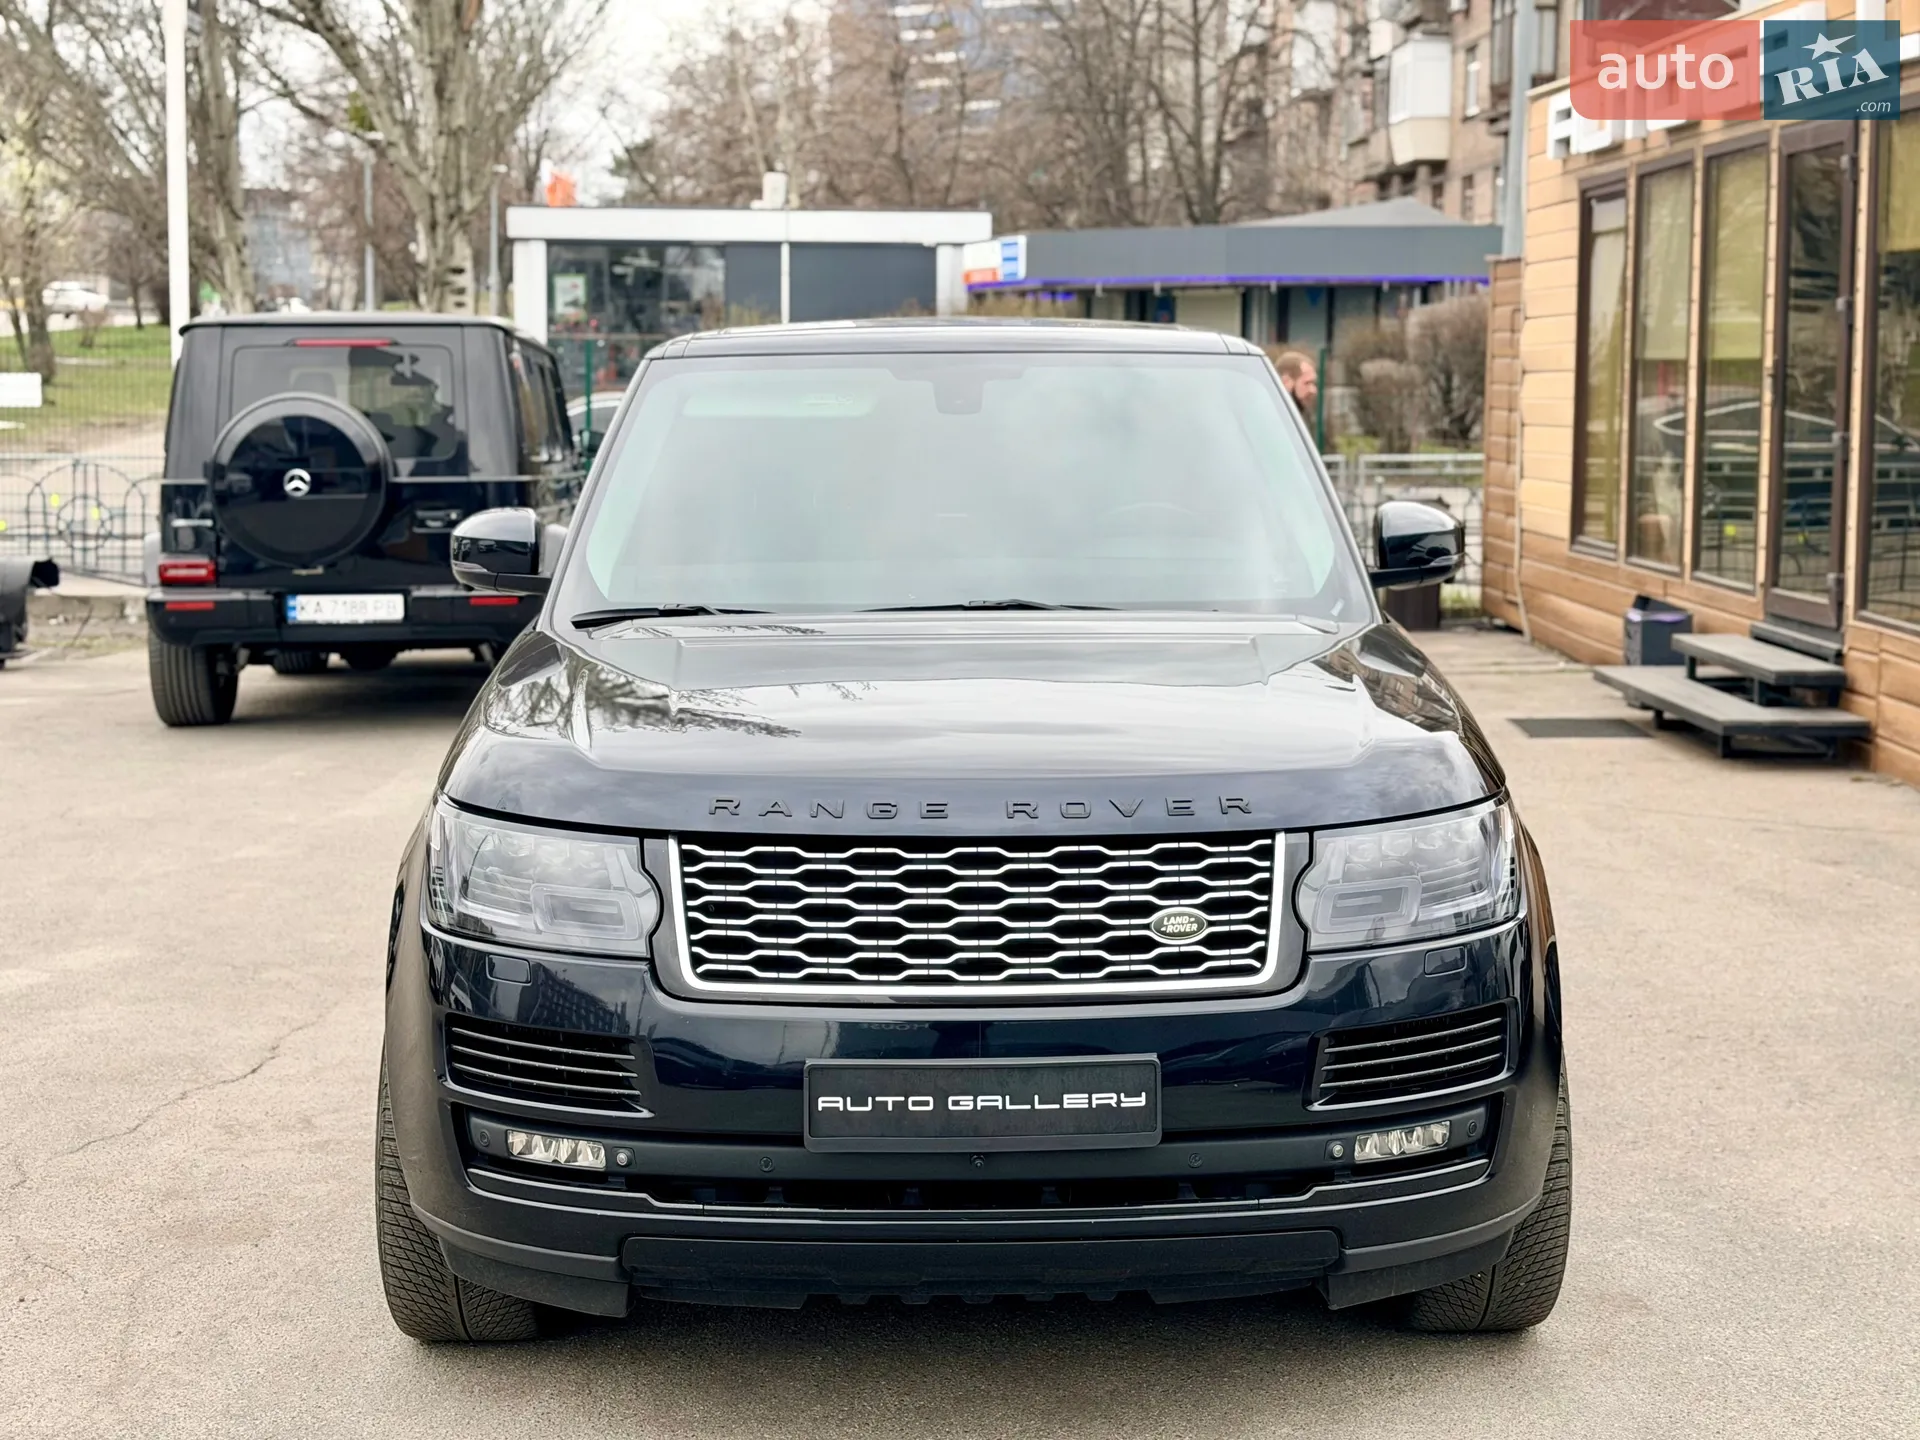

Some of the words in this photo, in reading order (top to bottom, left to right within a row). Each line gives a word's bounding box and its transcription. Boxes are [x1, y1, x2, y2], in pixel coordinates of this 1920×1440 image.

[707, 796, 950, 820] RANGE
[1005, 794, 1254, 819] ROVER
[1166, 923, 1198, 934] ROVER
[817, 1095, 934, 1112] AUTO
[947, 1091, 1147, 1111] GALLERY
